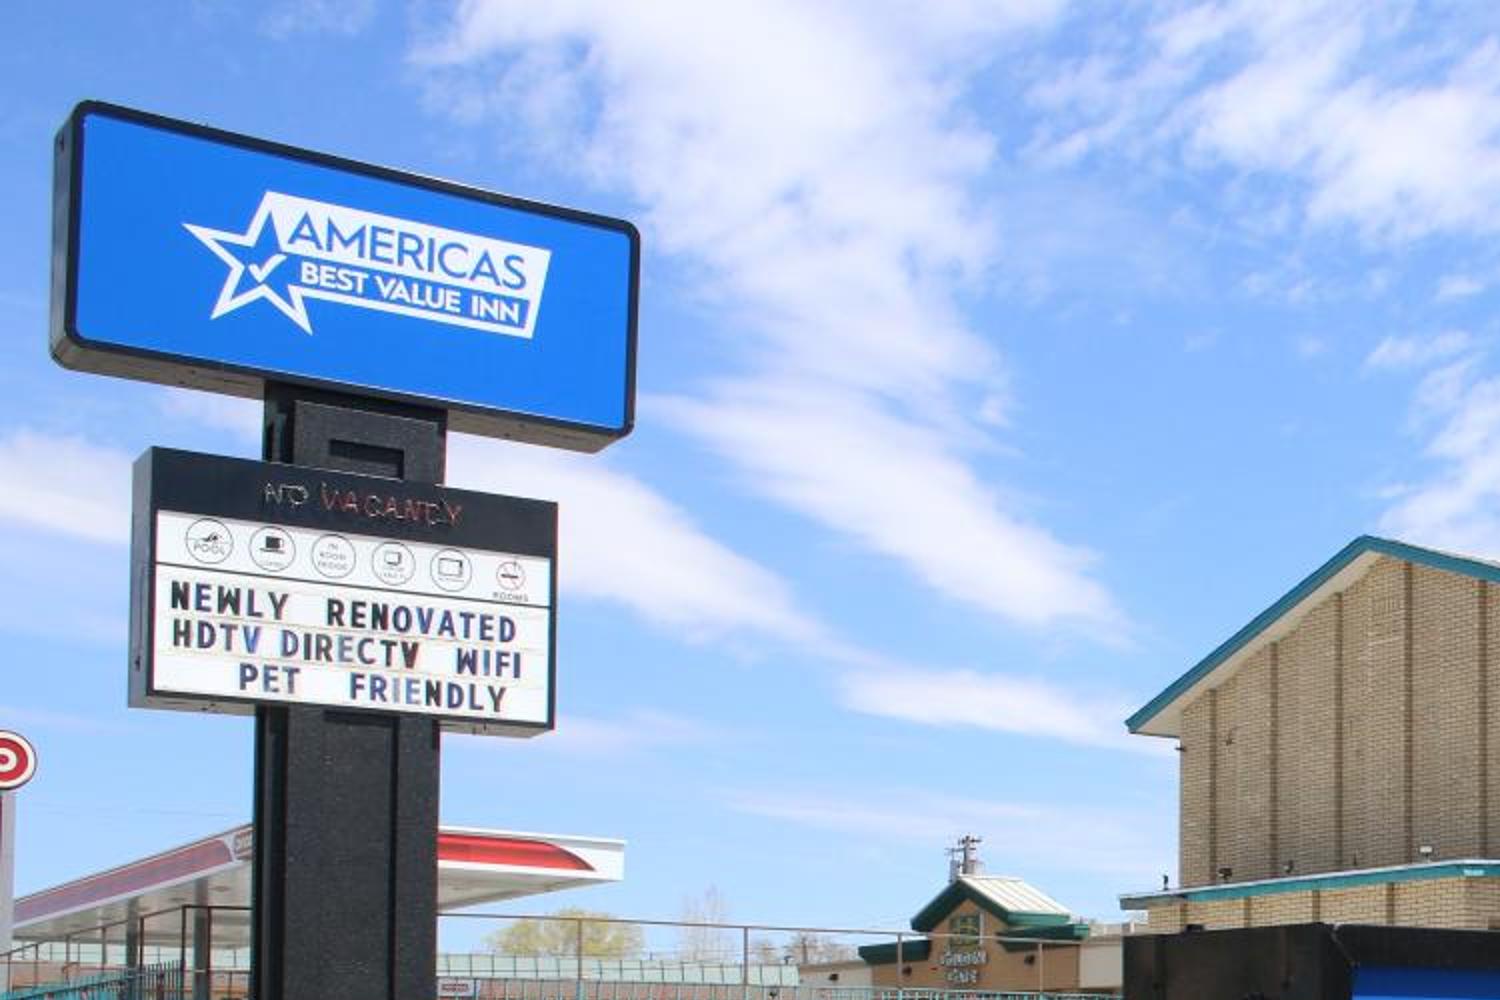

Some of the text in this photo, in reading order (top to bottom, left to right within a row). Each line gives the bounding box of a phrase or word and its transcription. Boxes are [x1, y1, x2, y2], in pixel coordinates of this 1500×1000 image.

[287, 211, 527, 290] AMERICAS
[301, 261, 519, 323] BEST VALUE INN
[320, 482, 463, 528] VACANCY
[171, 580, 517, 643] NEWLY RENOVATED
[173, 618, 522, 679] HDTV DIRECTV WIFI
[239, 662, 506, 713] PET FRIENDLY
